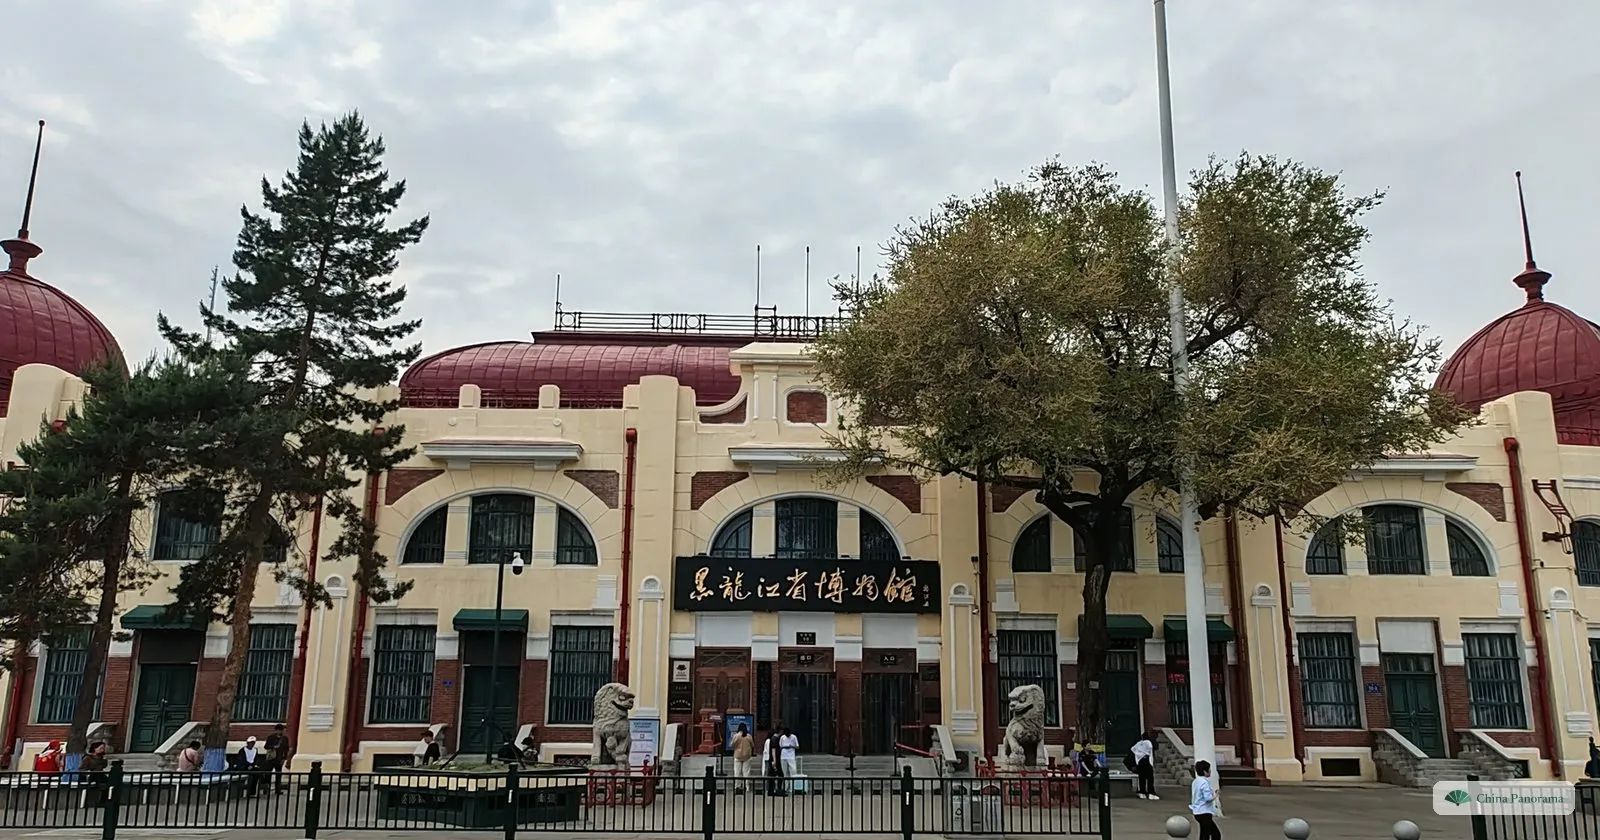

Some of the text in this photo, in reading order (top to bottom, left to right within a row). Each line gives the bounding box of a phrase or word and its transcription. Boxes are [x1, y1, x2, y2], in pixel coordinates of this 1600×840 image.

[689, 566, 917, 604] 黑龍江省博物館
